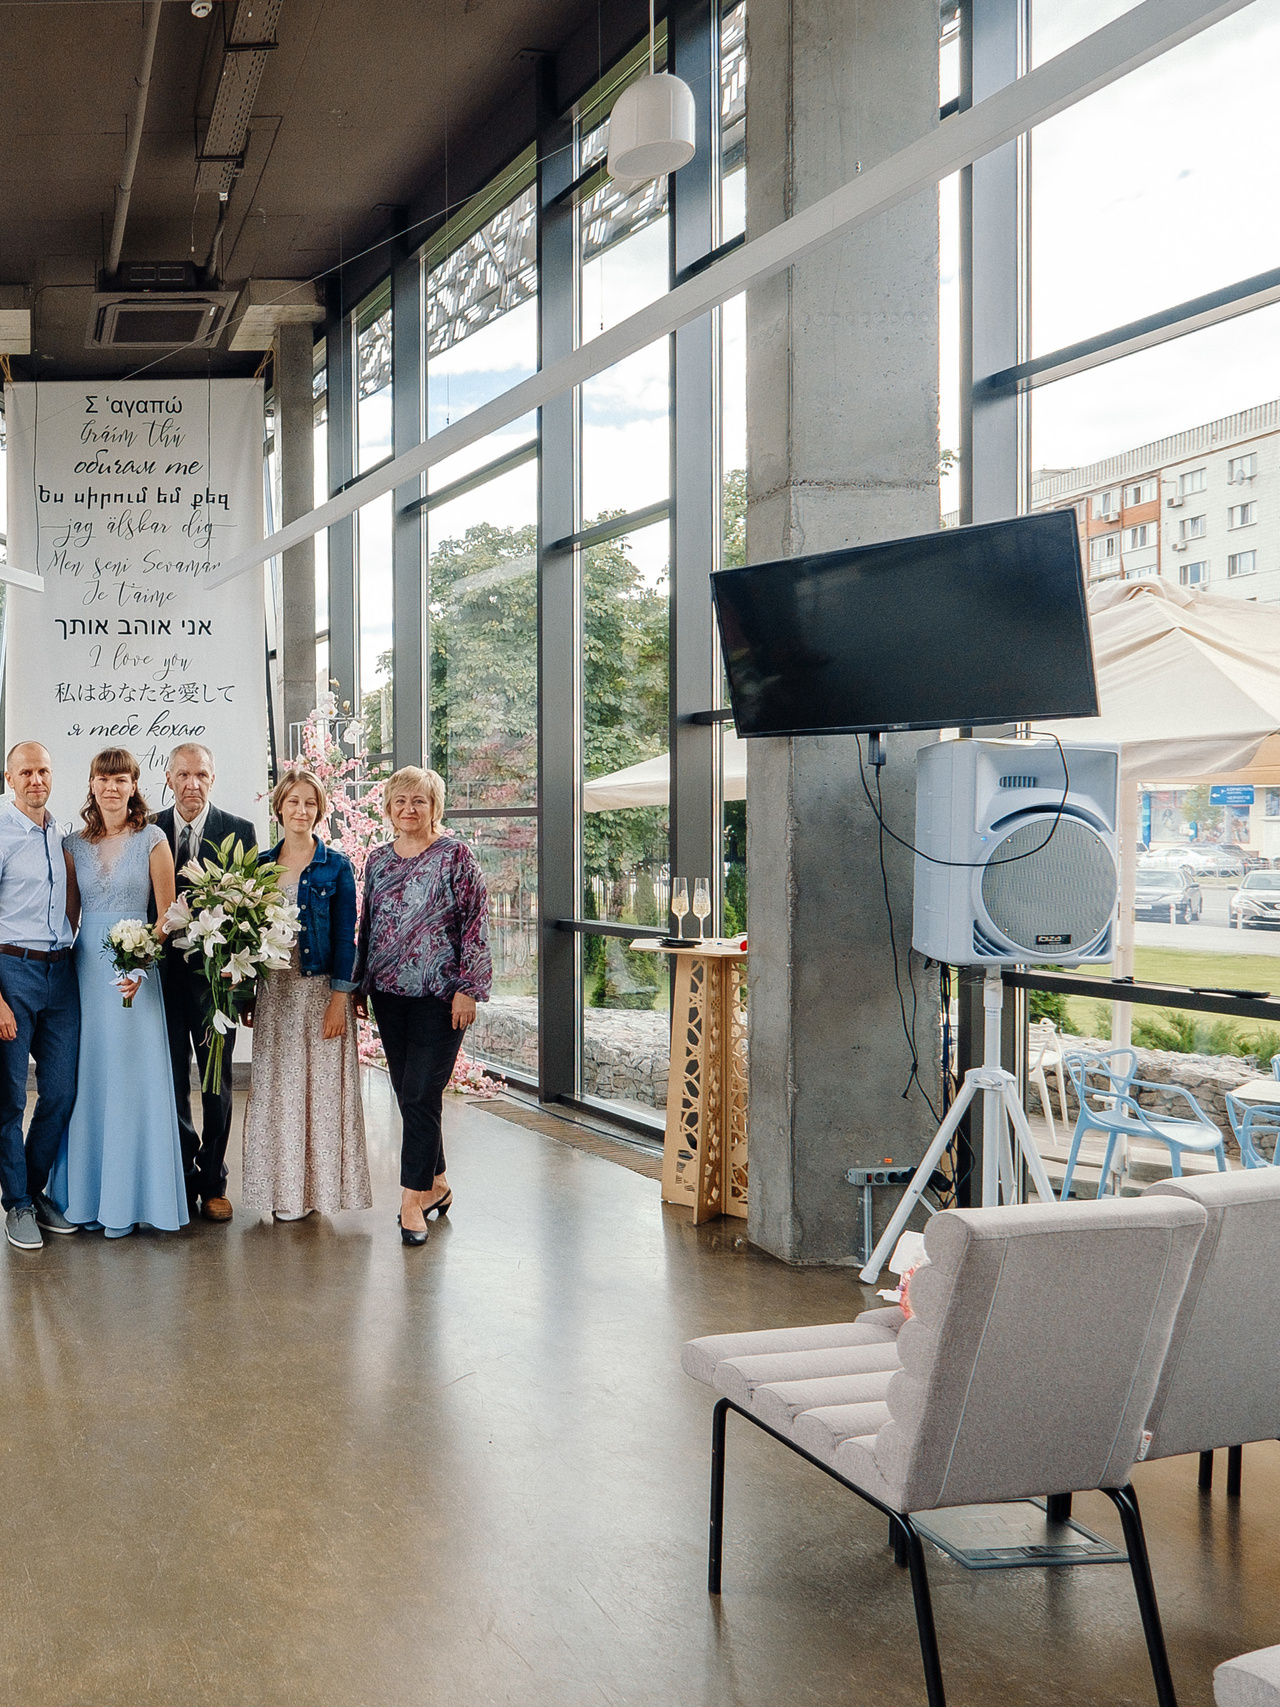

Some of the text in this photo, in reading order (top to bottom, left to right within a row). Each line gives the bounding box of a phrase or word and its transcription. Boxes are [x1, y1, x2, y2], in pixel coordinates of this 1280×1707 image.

[85, 395, 98, 414] Σ
[73, 449, 157, 475] обичам
[40, 508, 238, 550] jag älskar dig
[46, 549, 85, 577] Men
[92, 557, 134, 580] seni
[81, 579, 109, 606] Je
[54, 619, 213, 641] אני אוהב אותך
[88, 642, 194, 682] I love you
[54, 682, 236, 704] 私はあなたを愛して
[67, 709, 207, 739] я тебе кохаю
